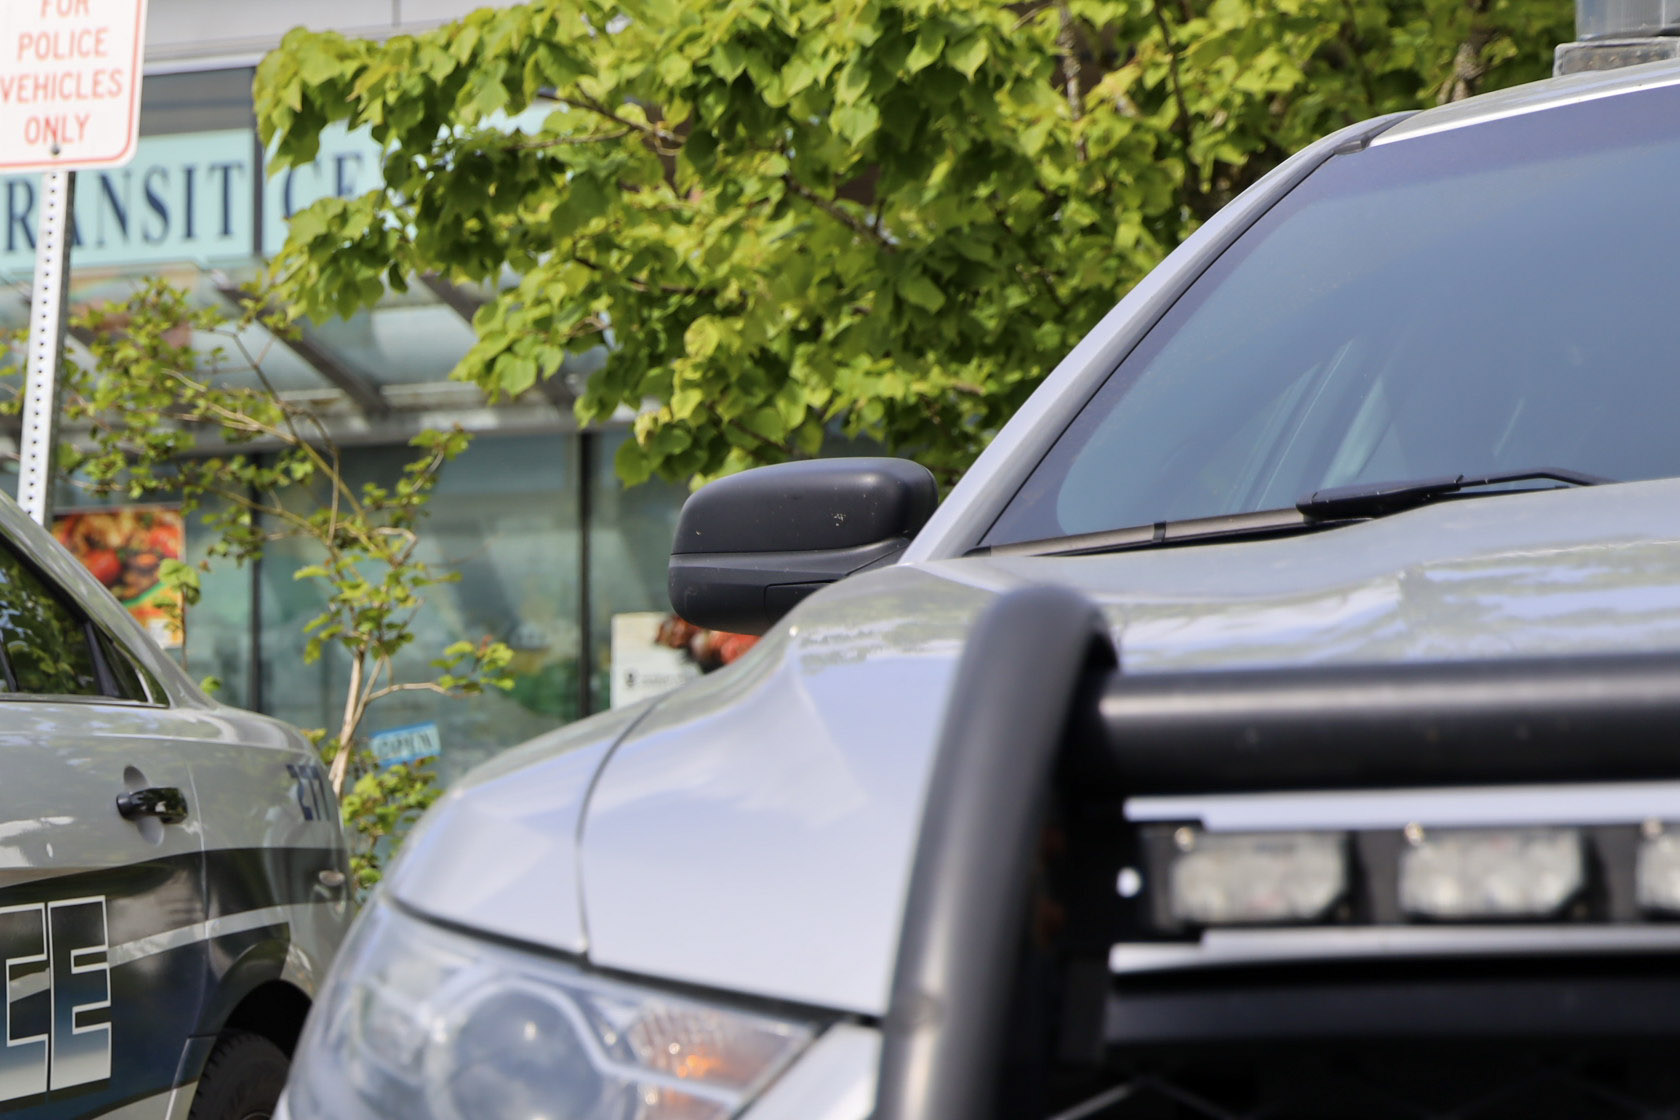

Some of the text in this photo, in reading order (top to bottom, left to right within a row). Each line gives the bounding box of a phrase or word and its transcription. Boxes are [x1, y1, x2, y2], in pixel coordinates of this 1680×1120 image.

[39, 0, 90, 18] FOR
[16, 27, 110, 62] POLICE
[0, 68, 124, 104] VEHICLES
[24, 112, 92, 145] ONLY
